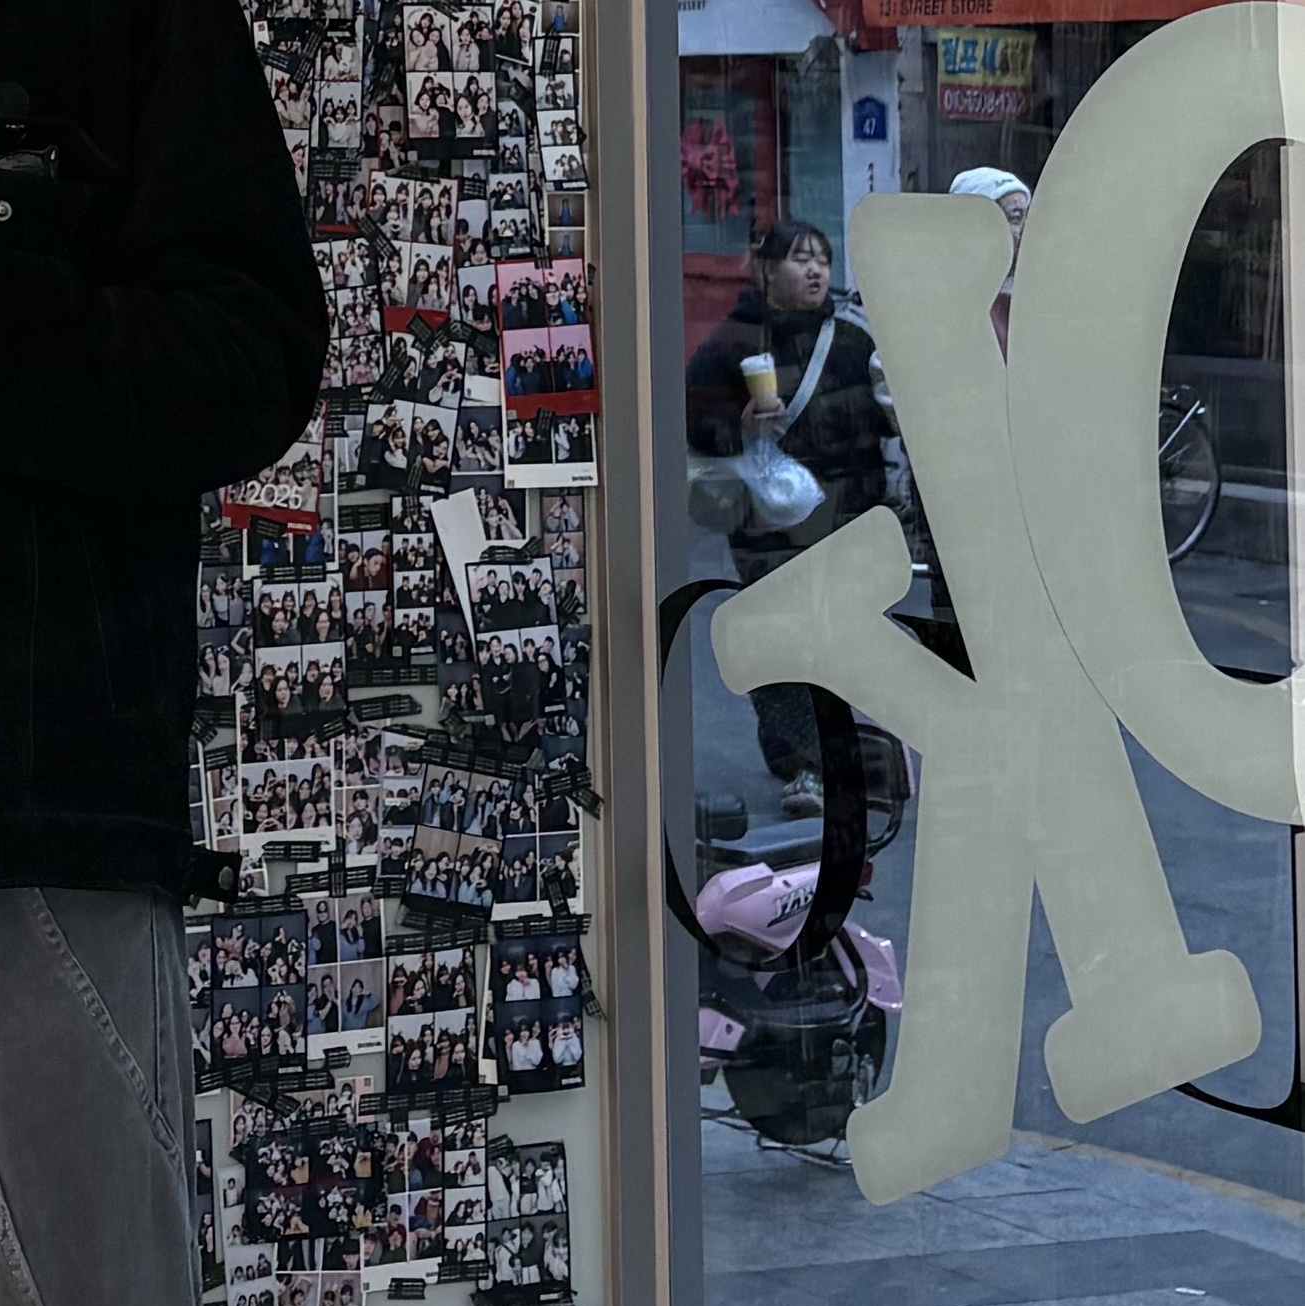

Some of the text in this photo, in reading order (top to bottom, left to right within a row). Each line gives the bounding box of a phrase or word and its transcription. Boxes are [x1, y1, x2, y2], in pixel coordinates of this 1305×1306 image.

[899, 0, 946, 16] STREET
[951, 0, 993, 15] STORE
[862, 117, 877, 136] 47
[246, 480, 303, 510] 2025
